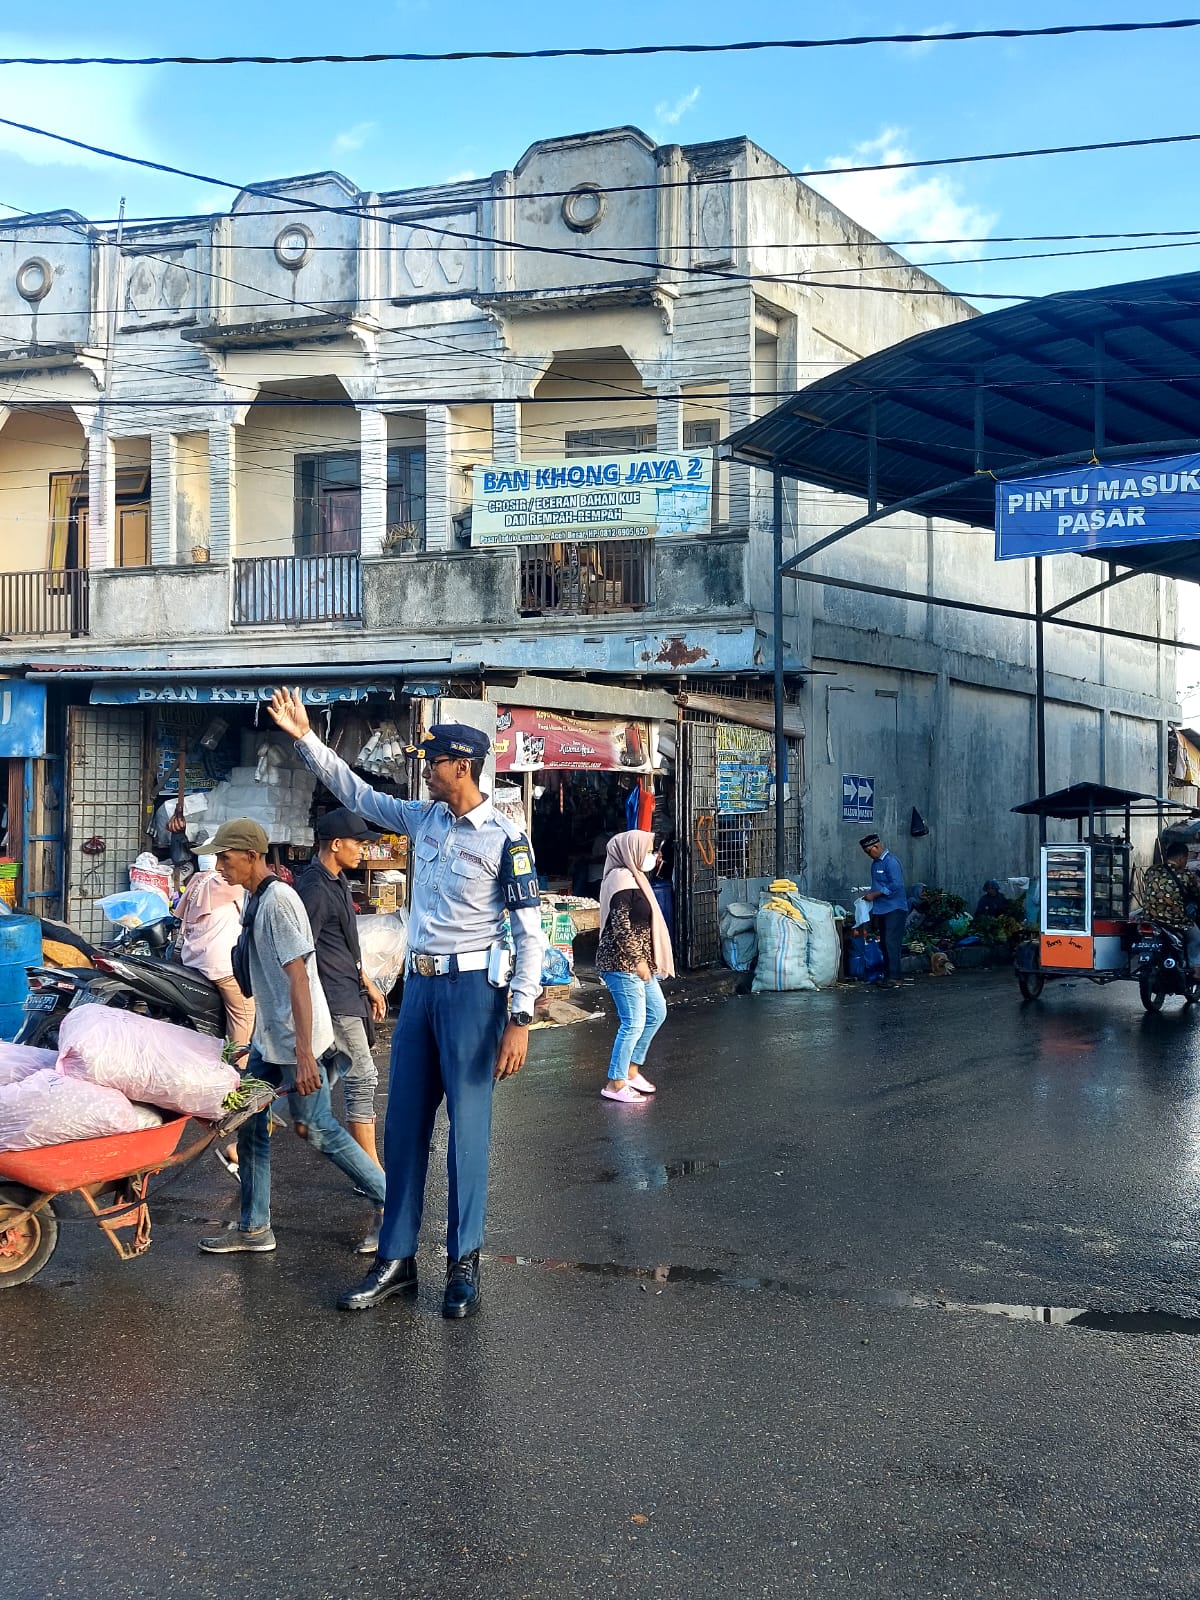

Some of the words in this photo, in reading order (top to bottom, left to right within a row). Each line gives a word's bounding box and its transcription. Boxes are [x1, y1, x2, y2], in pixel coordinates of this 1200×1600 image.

[484, 469, 530, 493] BAN
[535, 464, 620, 490] KHONG
[625, 459, 682, 484] JAYA
[687, 457, 702, 480] 2
[488, 498, 527, 513] GROSIR
[535, 494, 577, 510] ECERAN
[580, 491, 616, 507] BAHAN
[618, 490, 641, 505] KUE
[1008, 484, 1089, 514] PINTU
[1097, 473, 1200, 501] MASUK
[505, 513, 529, 527] DAN
[529, 507, 622, 526] REMPAH-REMPAH
[1057, 506, 1146, 535] PASAR
[136, 686, 198, 701] BAN
[209, 686, 330, 703] KHOG
